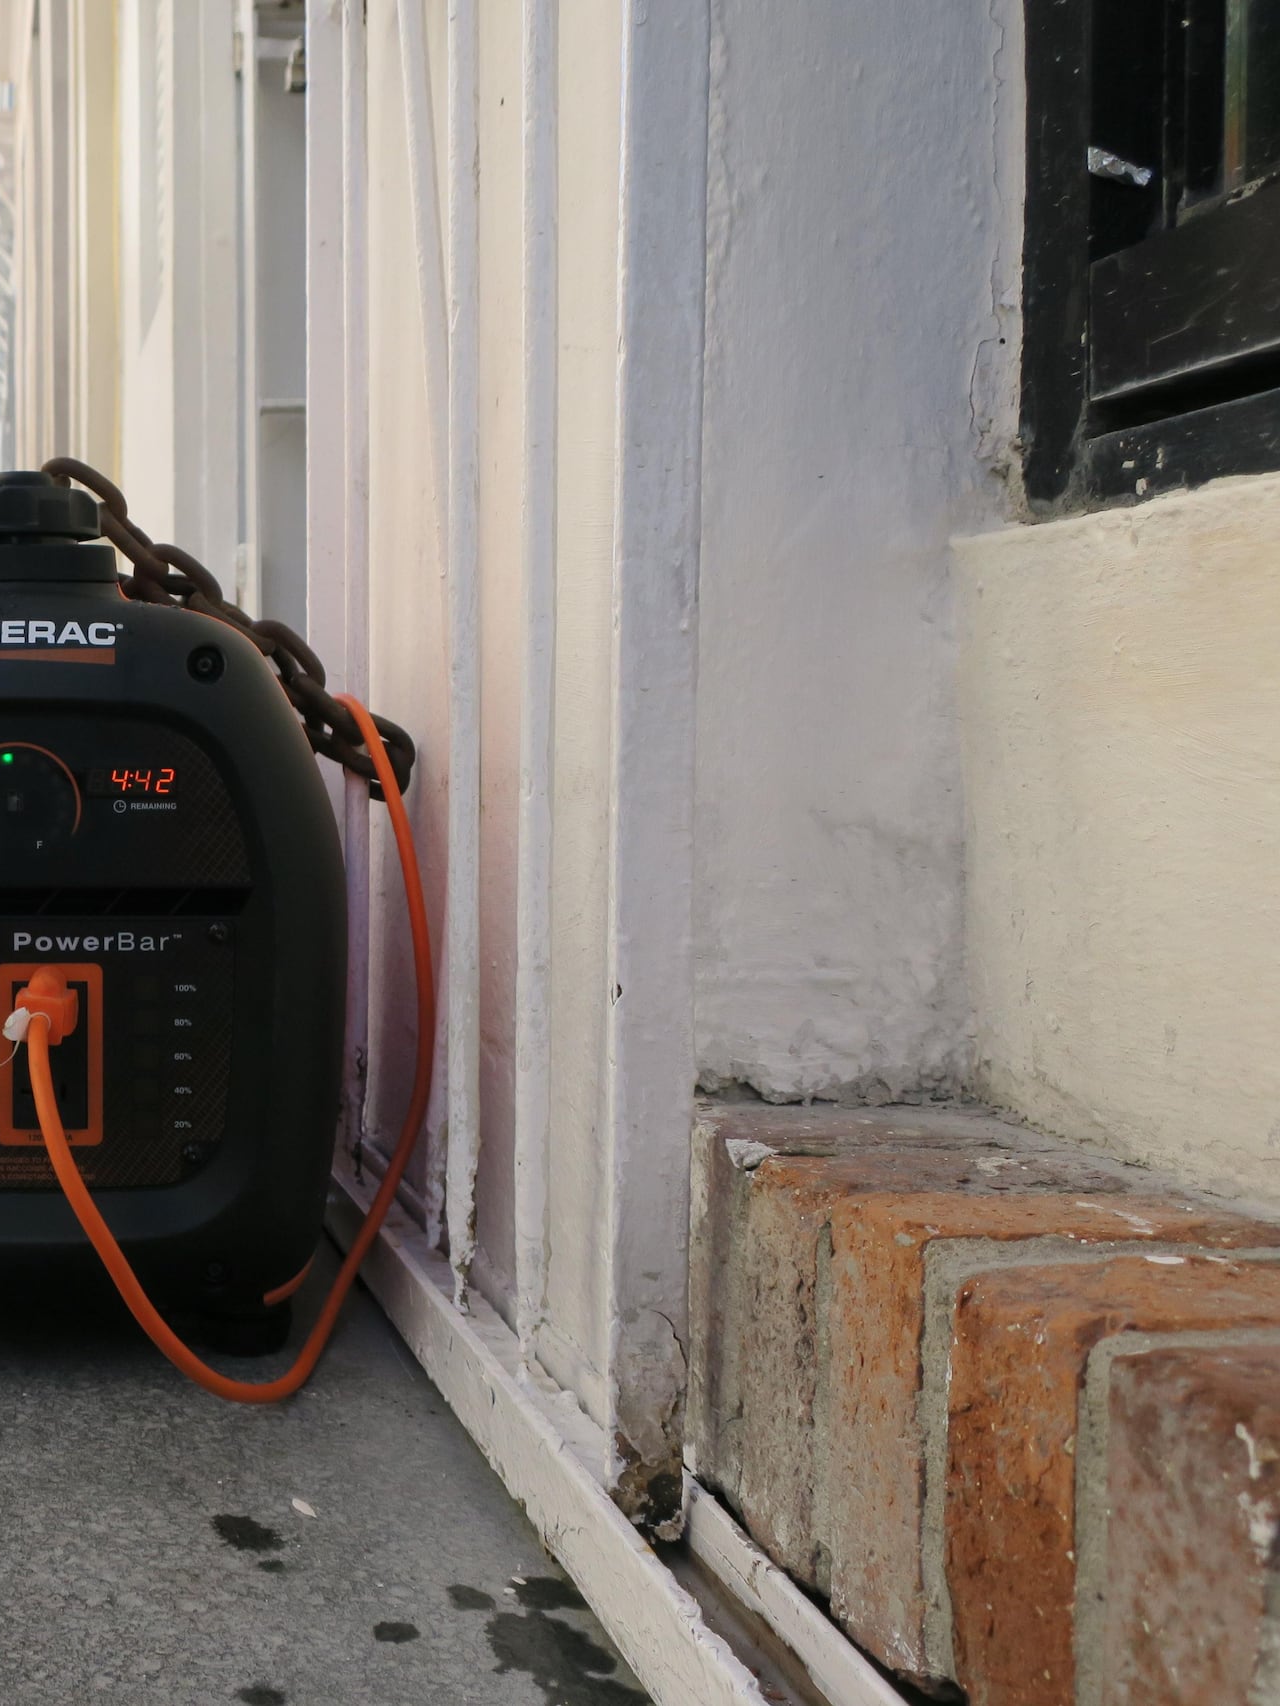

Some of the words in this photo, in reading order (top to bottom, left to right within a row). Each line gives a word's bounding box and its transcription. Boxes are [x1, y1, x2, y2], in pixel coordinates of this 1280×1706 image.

[111, 768, 175, 793] 4:42
[130, 802, 177, 810] REMAINING
[36, 840, 43, 849] F
[174, 984, 197, 993] 100%
[174, 1018, 193, 1027] 80%
[173, 1052, 193, 1061] 60%
[173, 1086, 193, 1095] 40%
[173, 1120, 193, 1129] 20%
[27, 1133, 43, 1142] 120
